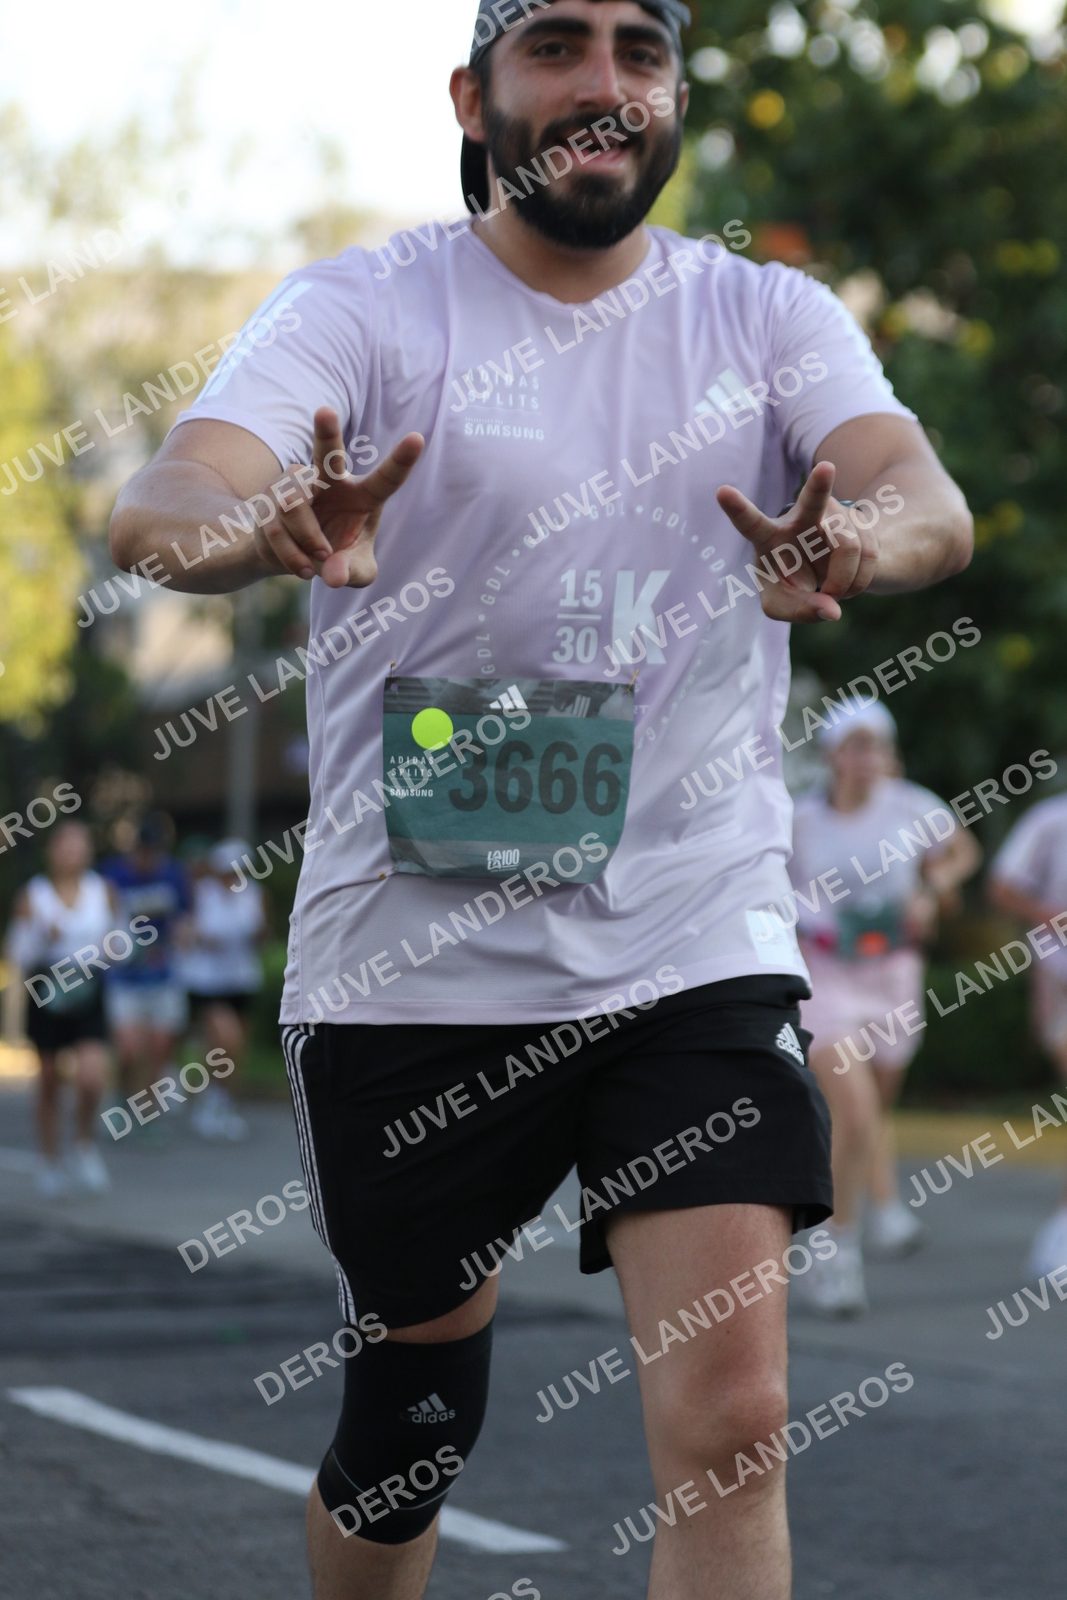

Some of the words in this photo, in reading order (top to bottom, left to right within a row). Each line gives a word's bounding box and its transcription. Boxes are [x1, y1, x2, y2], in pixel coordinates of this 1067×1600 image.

[464, 422, 545, 441] SAMSUNG
[480, 564, 511, 606] GDL
[559, 569, 603, 608] 15
[611, 570, 671, 664] K
[476, 633, 496, 675] GDL
[552, 626, 599, 664] 30
[389, 755, 434, 765] ADIDAS
[450, 740, 624, 817] 3666
[389, 788, 434, 798] SAMSUNG
[411, 1409, 456, 1424] didas
